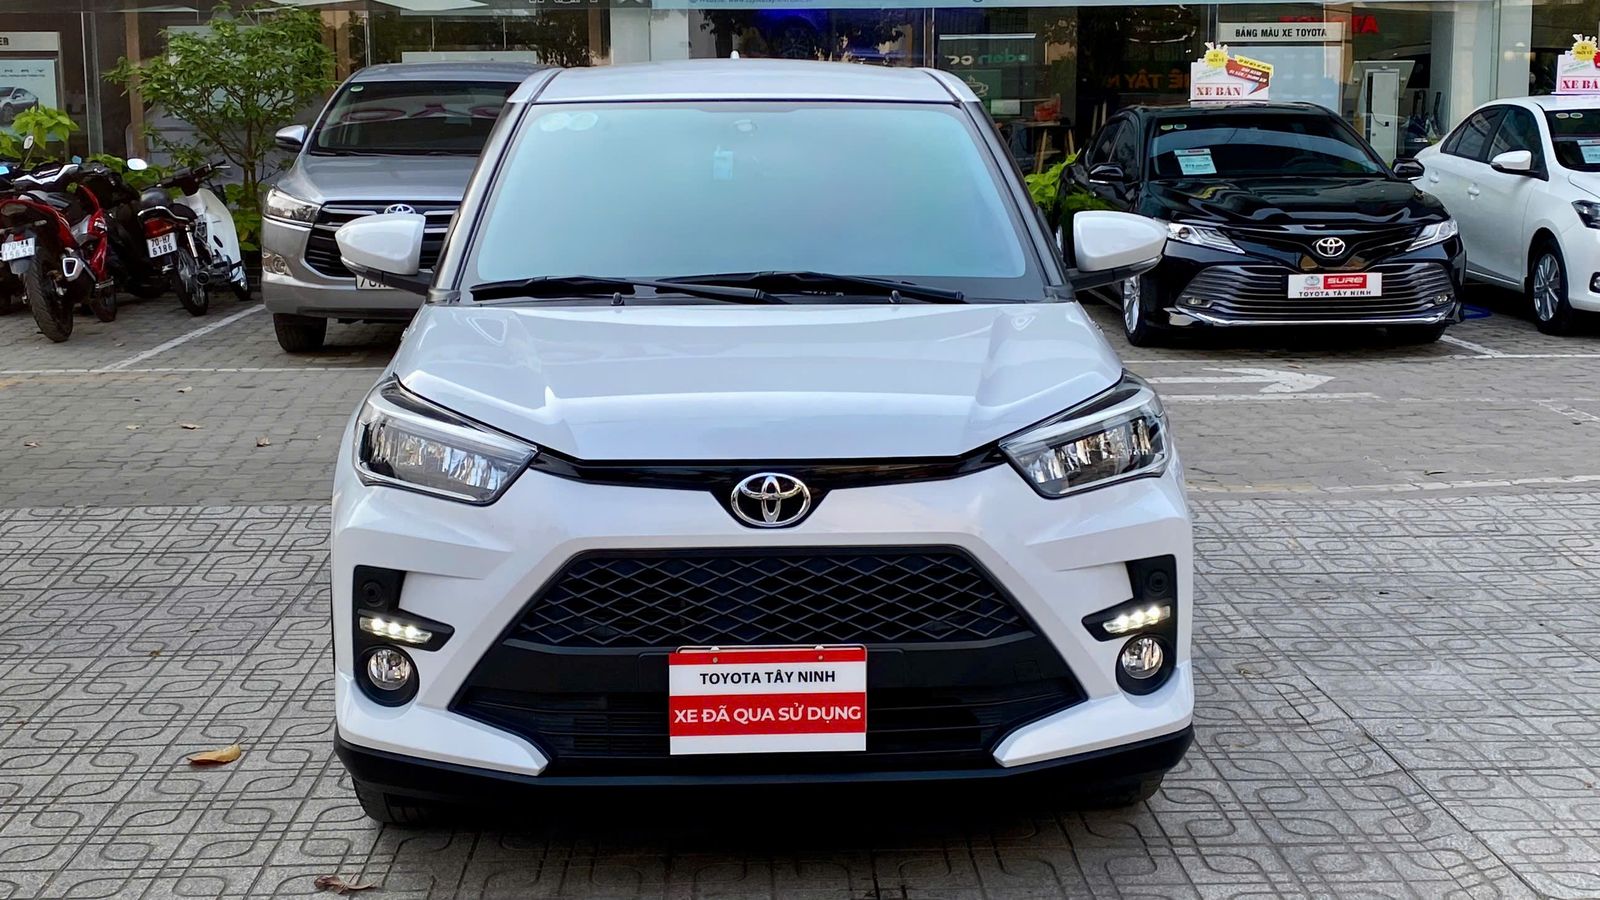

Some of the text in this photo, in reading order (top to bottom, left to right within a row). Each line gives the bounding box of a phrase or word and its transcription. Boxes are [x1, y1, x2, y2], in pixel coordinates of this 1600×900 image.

[1235, 26, 1327, 38] BẢNG MÀU XE TOYOTA
[1562, 78, 1599, 89] XE BÁ
[1196, 87, 1212, 96] XE
[700, 669, 836, 685] TOYOTA TÂY NINH
[674, 702, 862, 724] XE ĐÃ QUA SỬ DỤNG
